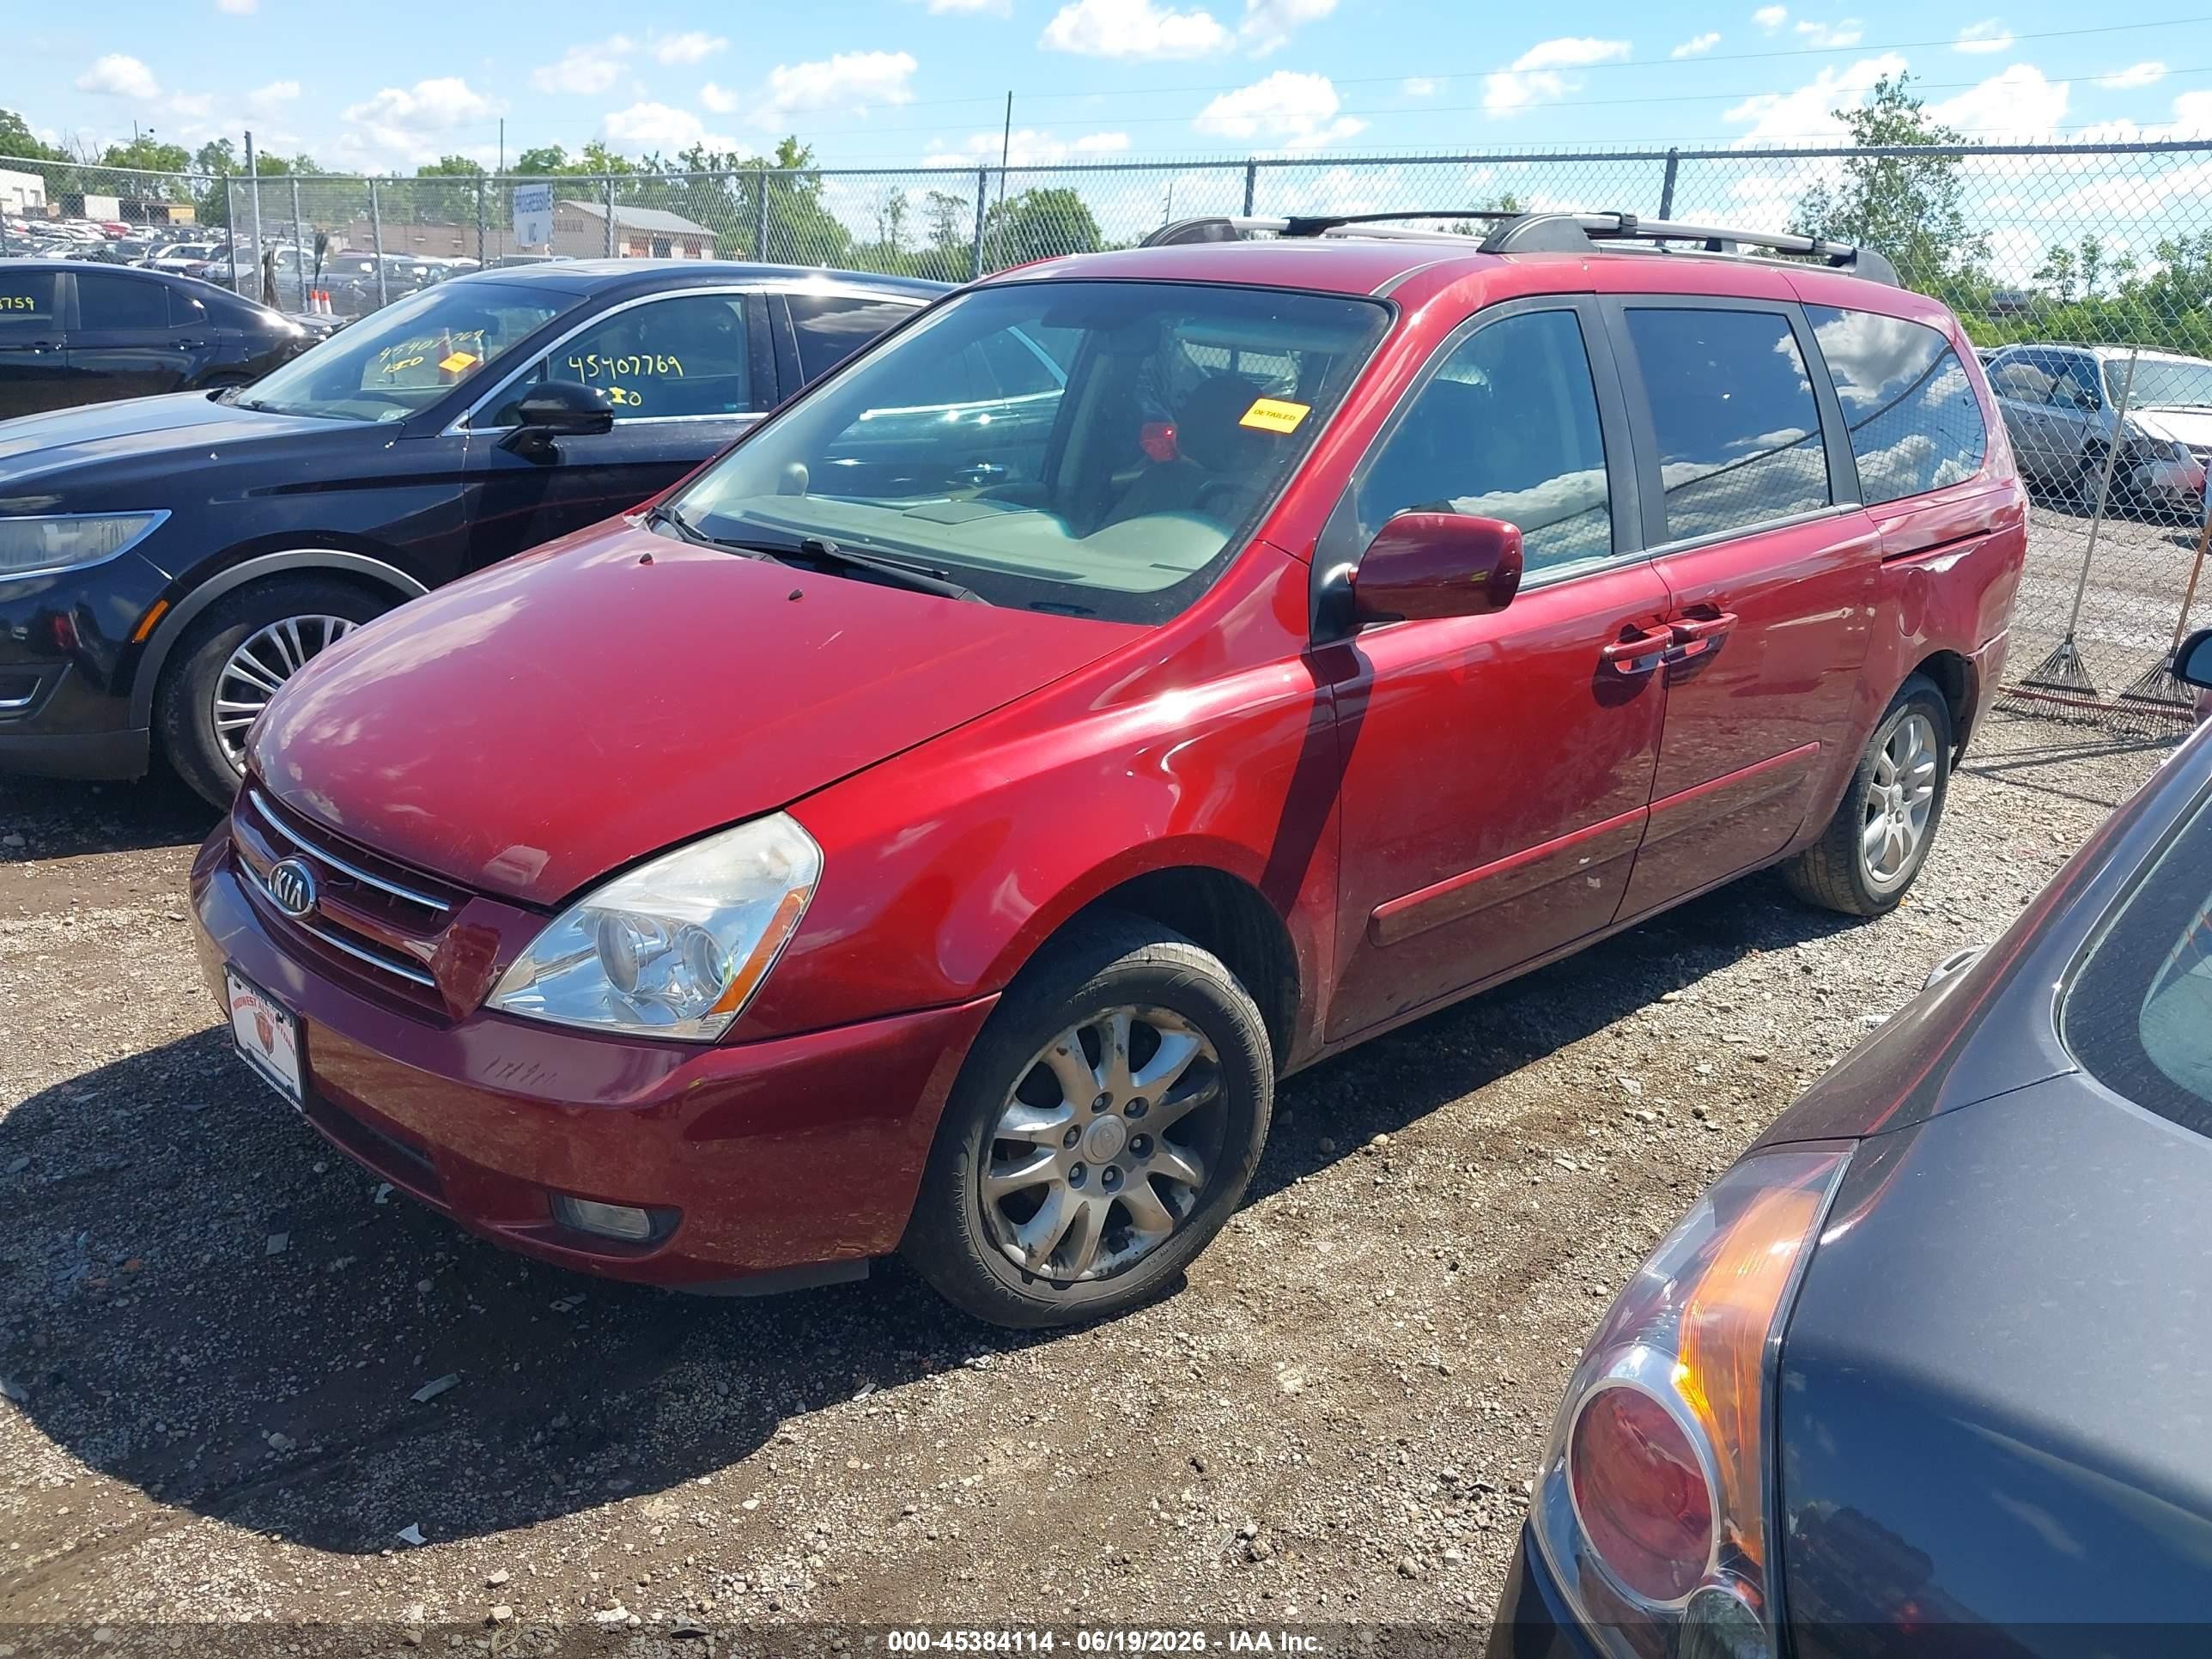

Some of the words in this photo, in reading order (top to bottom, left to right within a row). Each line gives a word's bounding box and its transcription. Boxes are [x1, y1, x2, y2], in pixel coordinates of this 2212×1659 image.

[568, 354, 684, 385] 45407769
[1254, 409, 1296, 421] DETAILED
[273, 866, 304, 910] KIA
[258, 998, 276, 1025] AUTO
